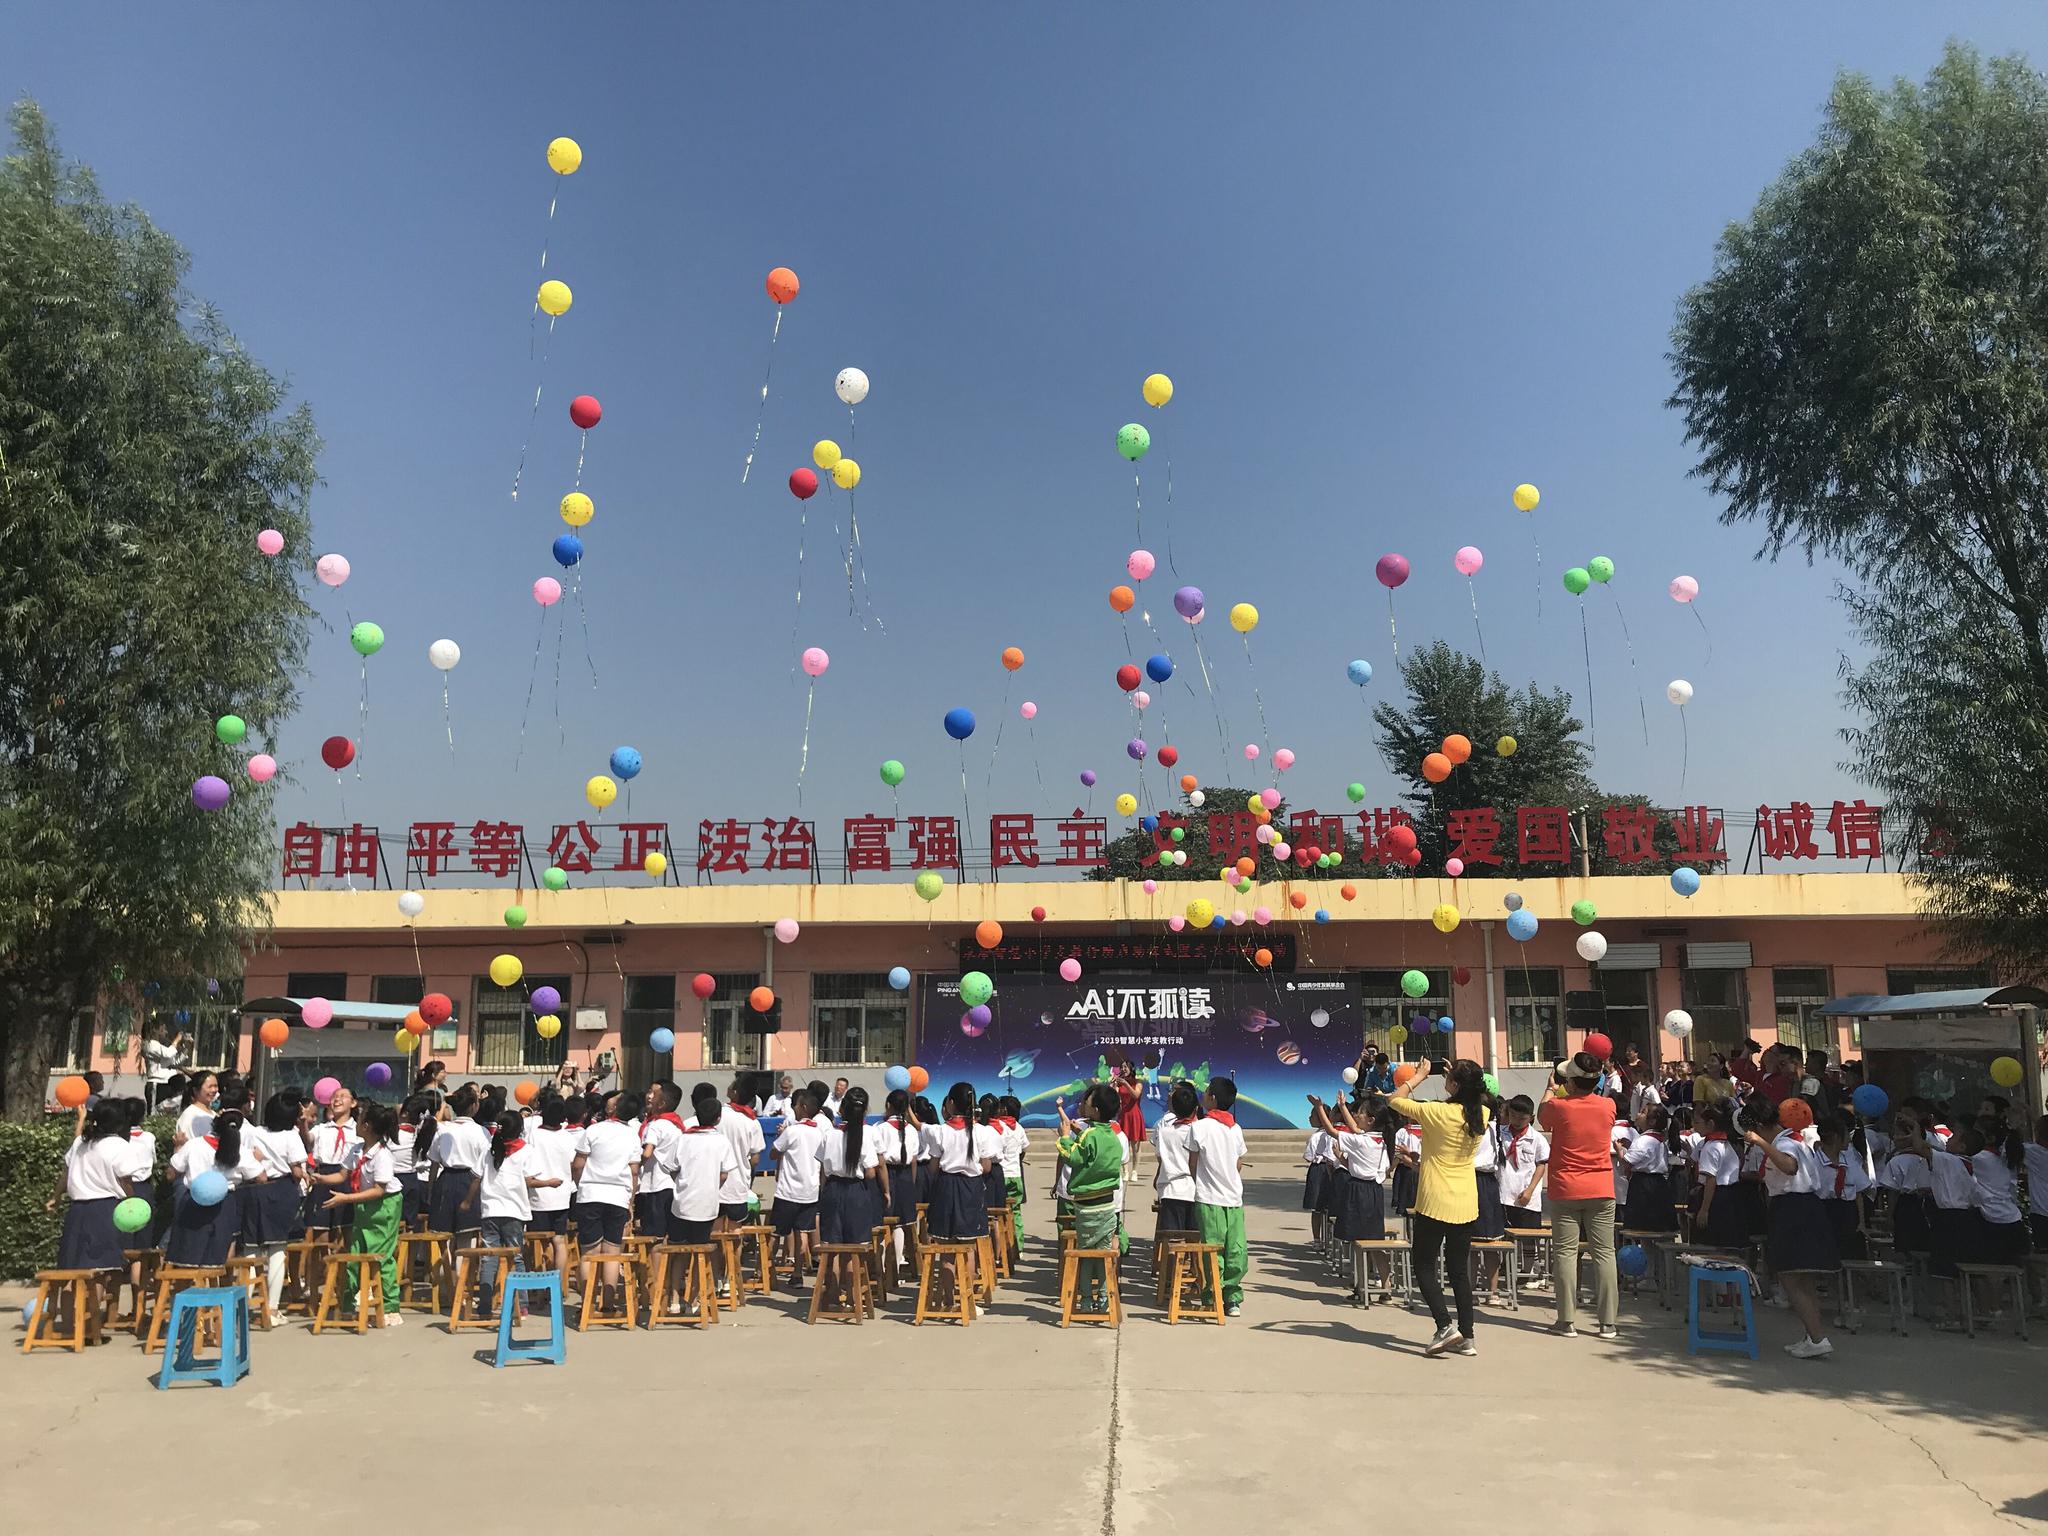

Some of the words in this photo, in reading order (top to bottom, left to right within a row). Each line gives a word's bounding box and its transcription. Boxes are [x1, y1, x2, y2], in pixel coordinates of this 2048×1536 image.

[283, 821, 378, 878] 自由
[408, 820, 522, 877] 平等
[547, 819, 664, 874] 公正
[698, 815, 813, 873] 法治
[844, 813, 960, 872] 富强
[991, 807, 1109, 868] 民主
[1139, 810, 1259, 867] 文明
[1446, 806, 1571, 866] 爱国
[1602, 805, 1727, 864] 敬业
[1758, 799, 1882, 860] 诚信
[1100, 1036, 1184, 1045] 2019智慧小学支教行动
